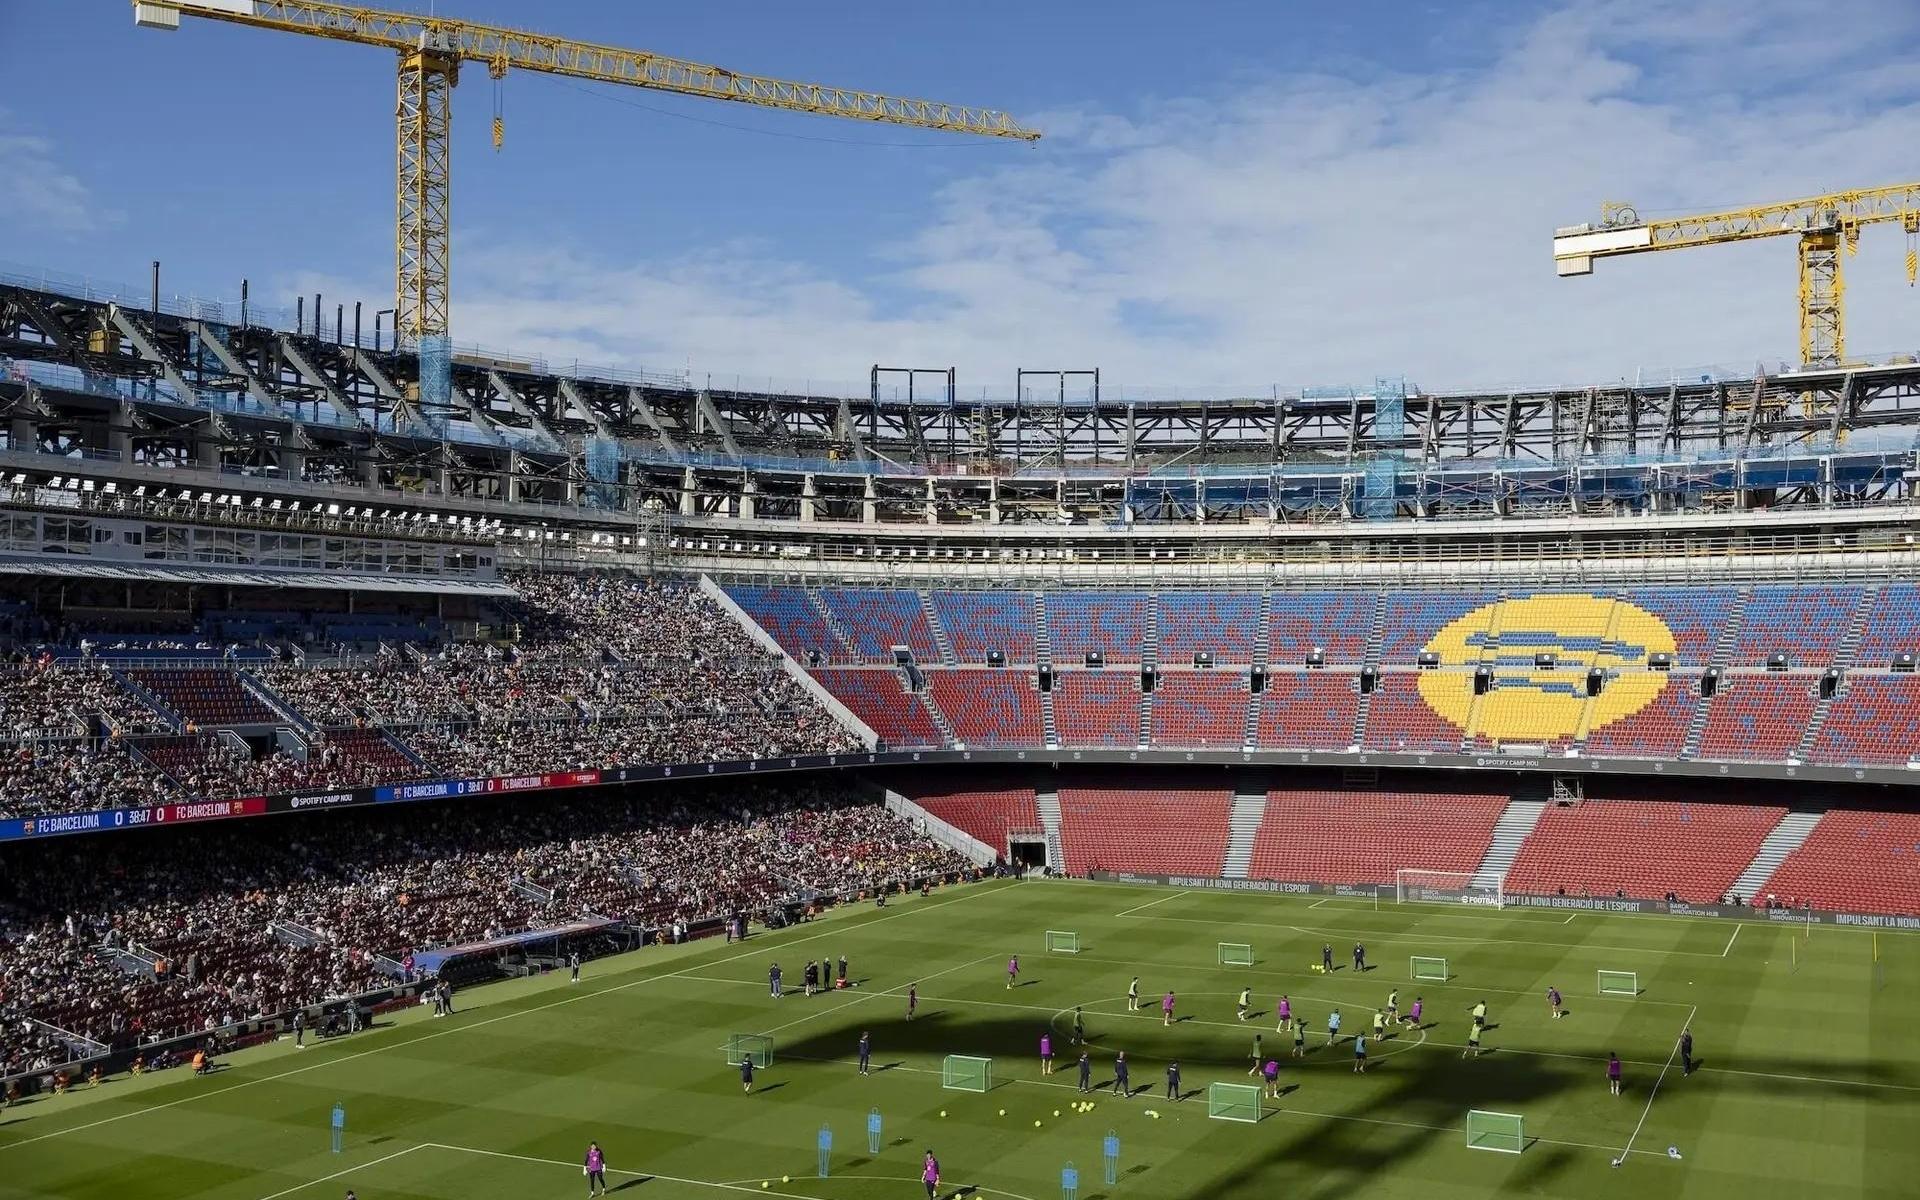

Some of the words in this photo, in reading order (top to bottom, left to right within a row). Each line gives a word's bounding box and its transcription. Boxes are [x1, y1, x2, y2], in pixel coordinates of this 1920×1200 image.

[403, 787, 412, 798] FC
[412, 784, 448, 798] BARCELONA
[457, 782, 464, 794] 0
[468, 781, 484, 793] 38:47
[487, 780, 494, 791] 0
[501, 779, 509, 790] FC
[510, 777, 541, 789] BARCELONA
[299, 796, 323, 806] SPOTIFY
[323, 795, 340, 804] CAMP
[341, 794, 353, 802] NOU
[38, 819, 50, 833] FC
[50, 814, 100, 832] BARCELONA
[114, 811, 123, 826] 0
[129, 809, 151, 824] 38:47
[156, 807, 165, 821] 0
[176, 806, 186, 820] FC
[187, 802, 230, 818] BARCELONA
[1168, 876, 1205, 888] IMPULSANT
[1206, 879, 1214, 888] LA
[1214, 879, 1232, 889] NOVA
[1233, 880, 1270, 891] GENERACIÓ
[1270, 882, 1279, 892] DE
[1279, 882, 1310, 894] L'ESPORT
[1521, 896, 1530, 905] LA
[1531, 897, 1551, 907] NOVA
[1552, 898, 1593, 909] GENERACIÓ
[1594, 901, 1605, 910] DE
[1606, 901, 1640, 912] L'ESPORT
[1769, 908, 1789, 916] BARÇA
[1769, 914, 1806, 922] INNOVATION
[1836, 914, 1884, 926] IMPULSANT
[1885, 917, 1896, 927] LA
[1897, 917, 1920, 928] NOVA
